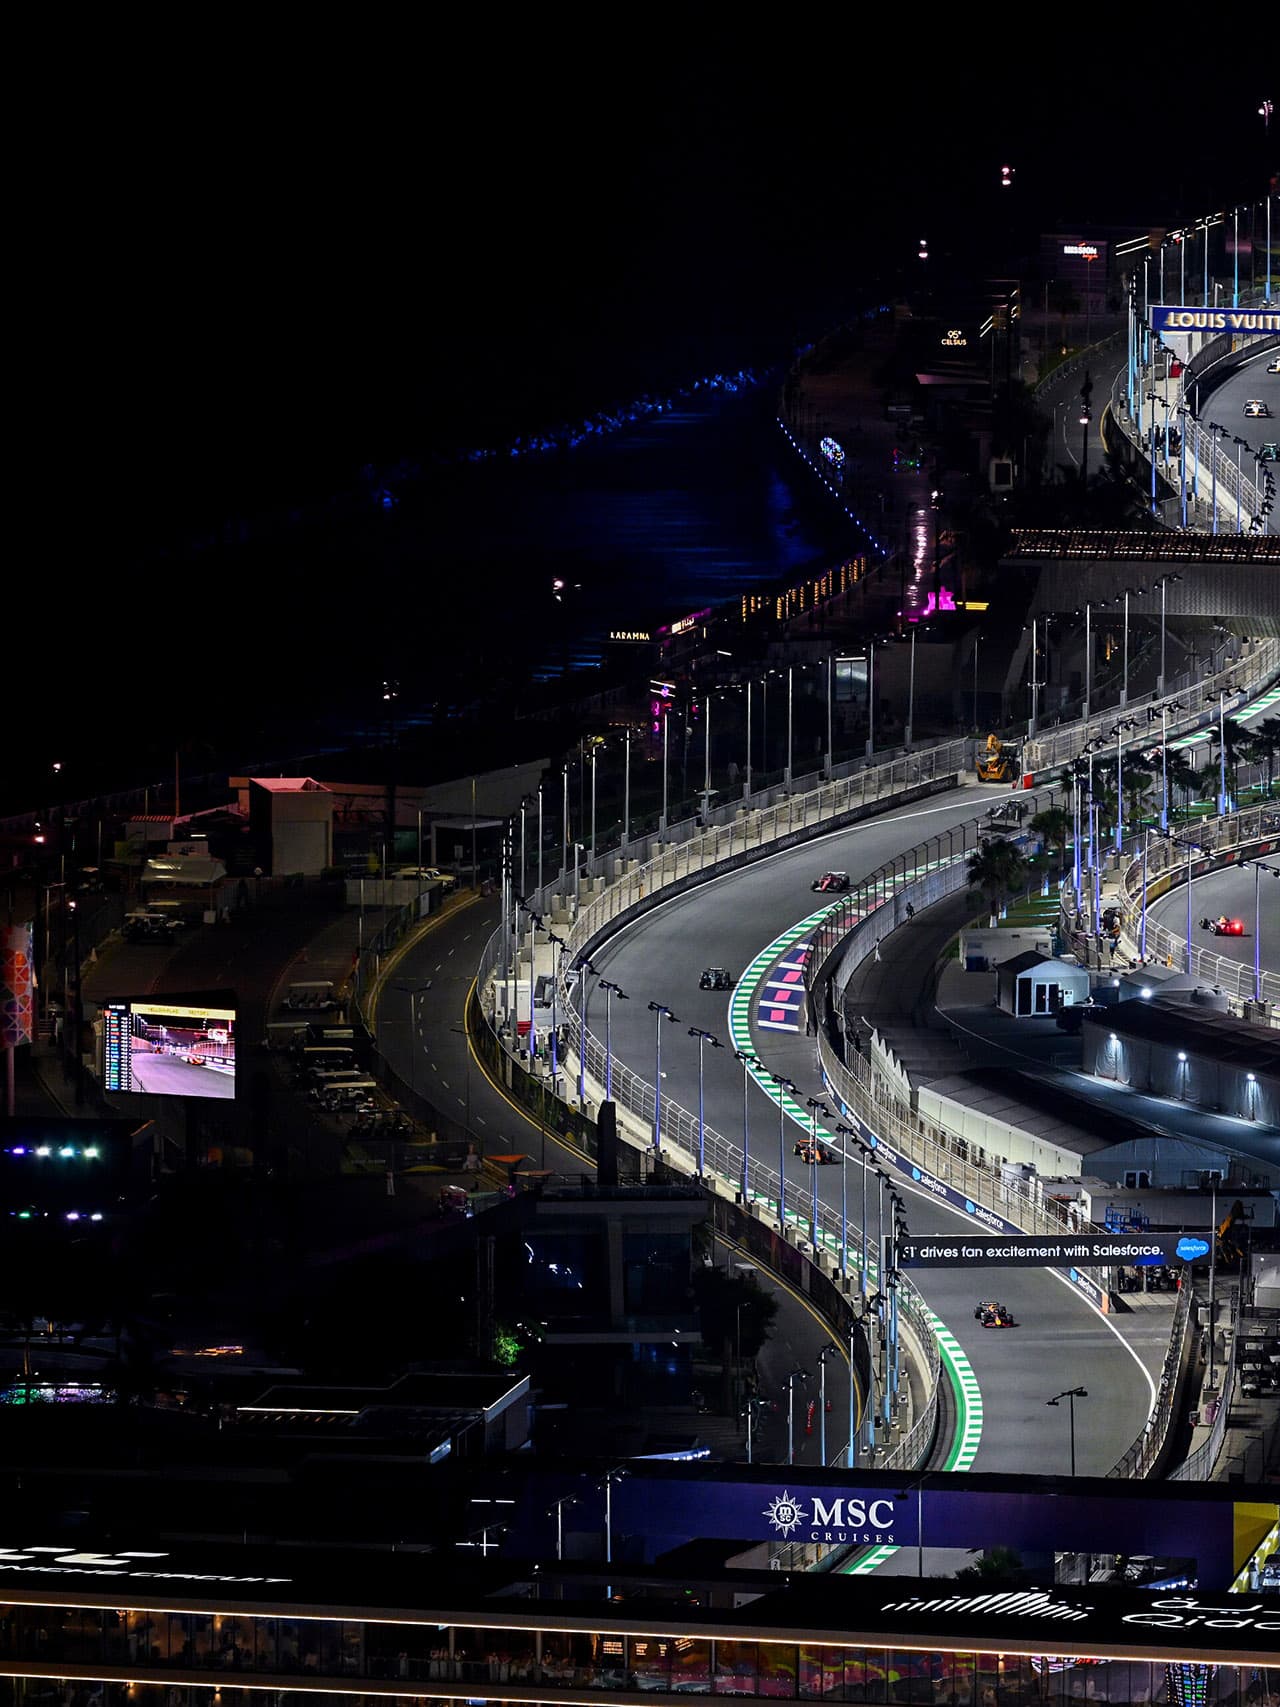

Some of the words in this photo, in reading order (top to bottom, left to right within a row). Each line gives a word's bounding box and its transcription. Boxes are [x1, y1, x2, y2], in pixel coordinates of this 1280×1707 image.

[1167, 312, 1226, 328] LOUIS
[921, 1174, 948, 1197] salesforce
[976, 1207, 1004, 1230] salesforce
[920, 1246, 958, 1258] drives
[961, 1246, 983, 1257] fan
[986, 1245, 1060, 1257] excitement
[1064, 1245, 1089, 1256] with
[1093, 1244, 1164, 1256] Salesforce.
[811, 1498, 894, 1528] MSC
[811, 1532, 894, 1543] CRUISES
[129, 1572, 293, 1583] CIRCUIT
